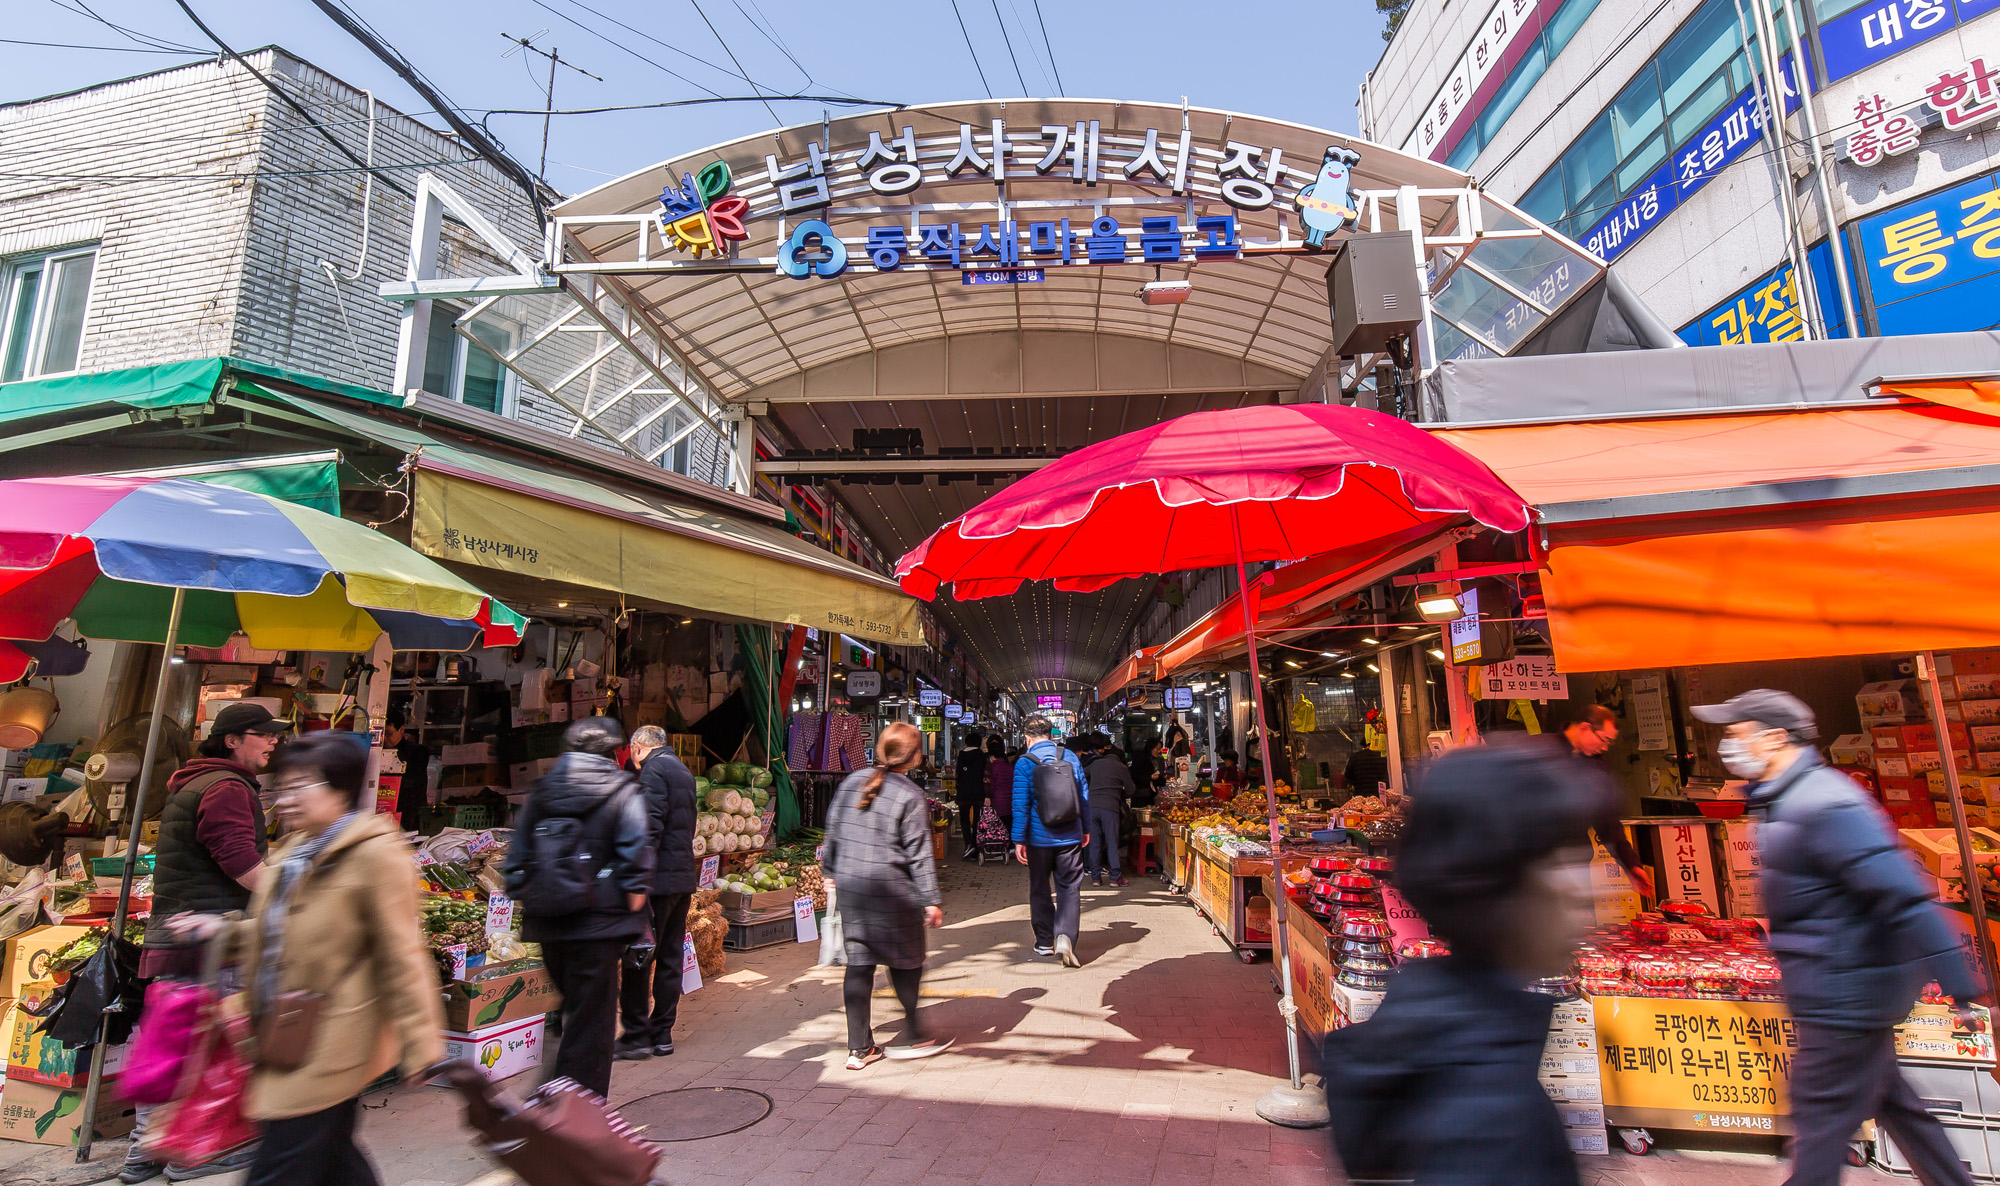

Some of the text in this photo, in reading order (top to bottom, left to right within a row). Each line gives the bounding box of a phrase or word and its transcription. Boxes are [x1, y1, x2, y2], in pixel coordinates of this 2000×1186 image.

[1424, 76, 1463, 146] 참좋은
[1853, 94, 1886, 129] 참
[1849, 117, 1915, 163] 좋은
[766, 118, 1289, 214] 남성사계시장
[866, 213, 1242, 274] 동작새마을금고
[985, 269, 1039, 282] 50M 전방
[463, 534, 539, 564] 남성사계시장
[827, 611, 855, 627] 한가득채소
[866, 621, 892, 635] 593-5732
[1454, 643, 1480, 660] 533-5870
[1507, 680, 1561, 691] 포인트적립
[1655, 1013, 1799, 1048] 쿠팡이츠 신속배달
[1604, 1044, 1799, 1082] 제로페이 온누리 동작사
[1692, 1083, 1777, 1106] 02.533.5870
[1709, 1114, 1773, 1131] 남성사계시장
